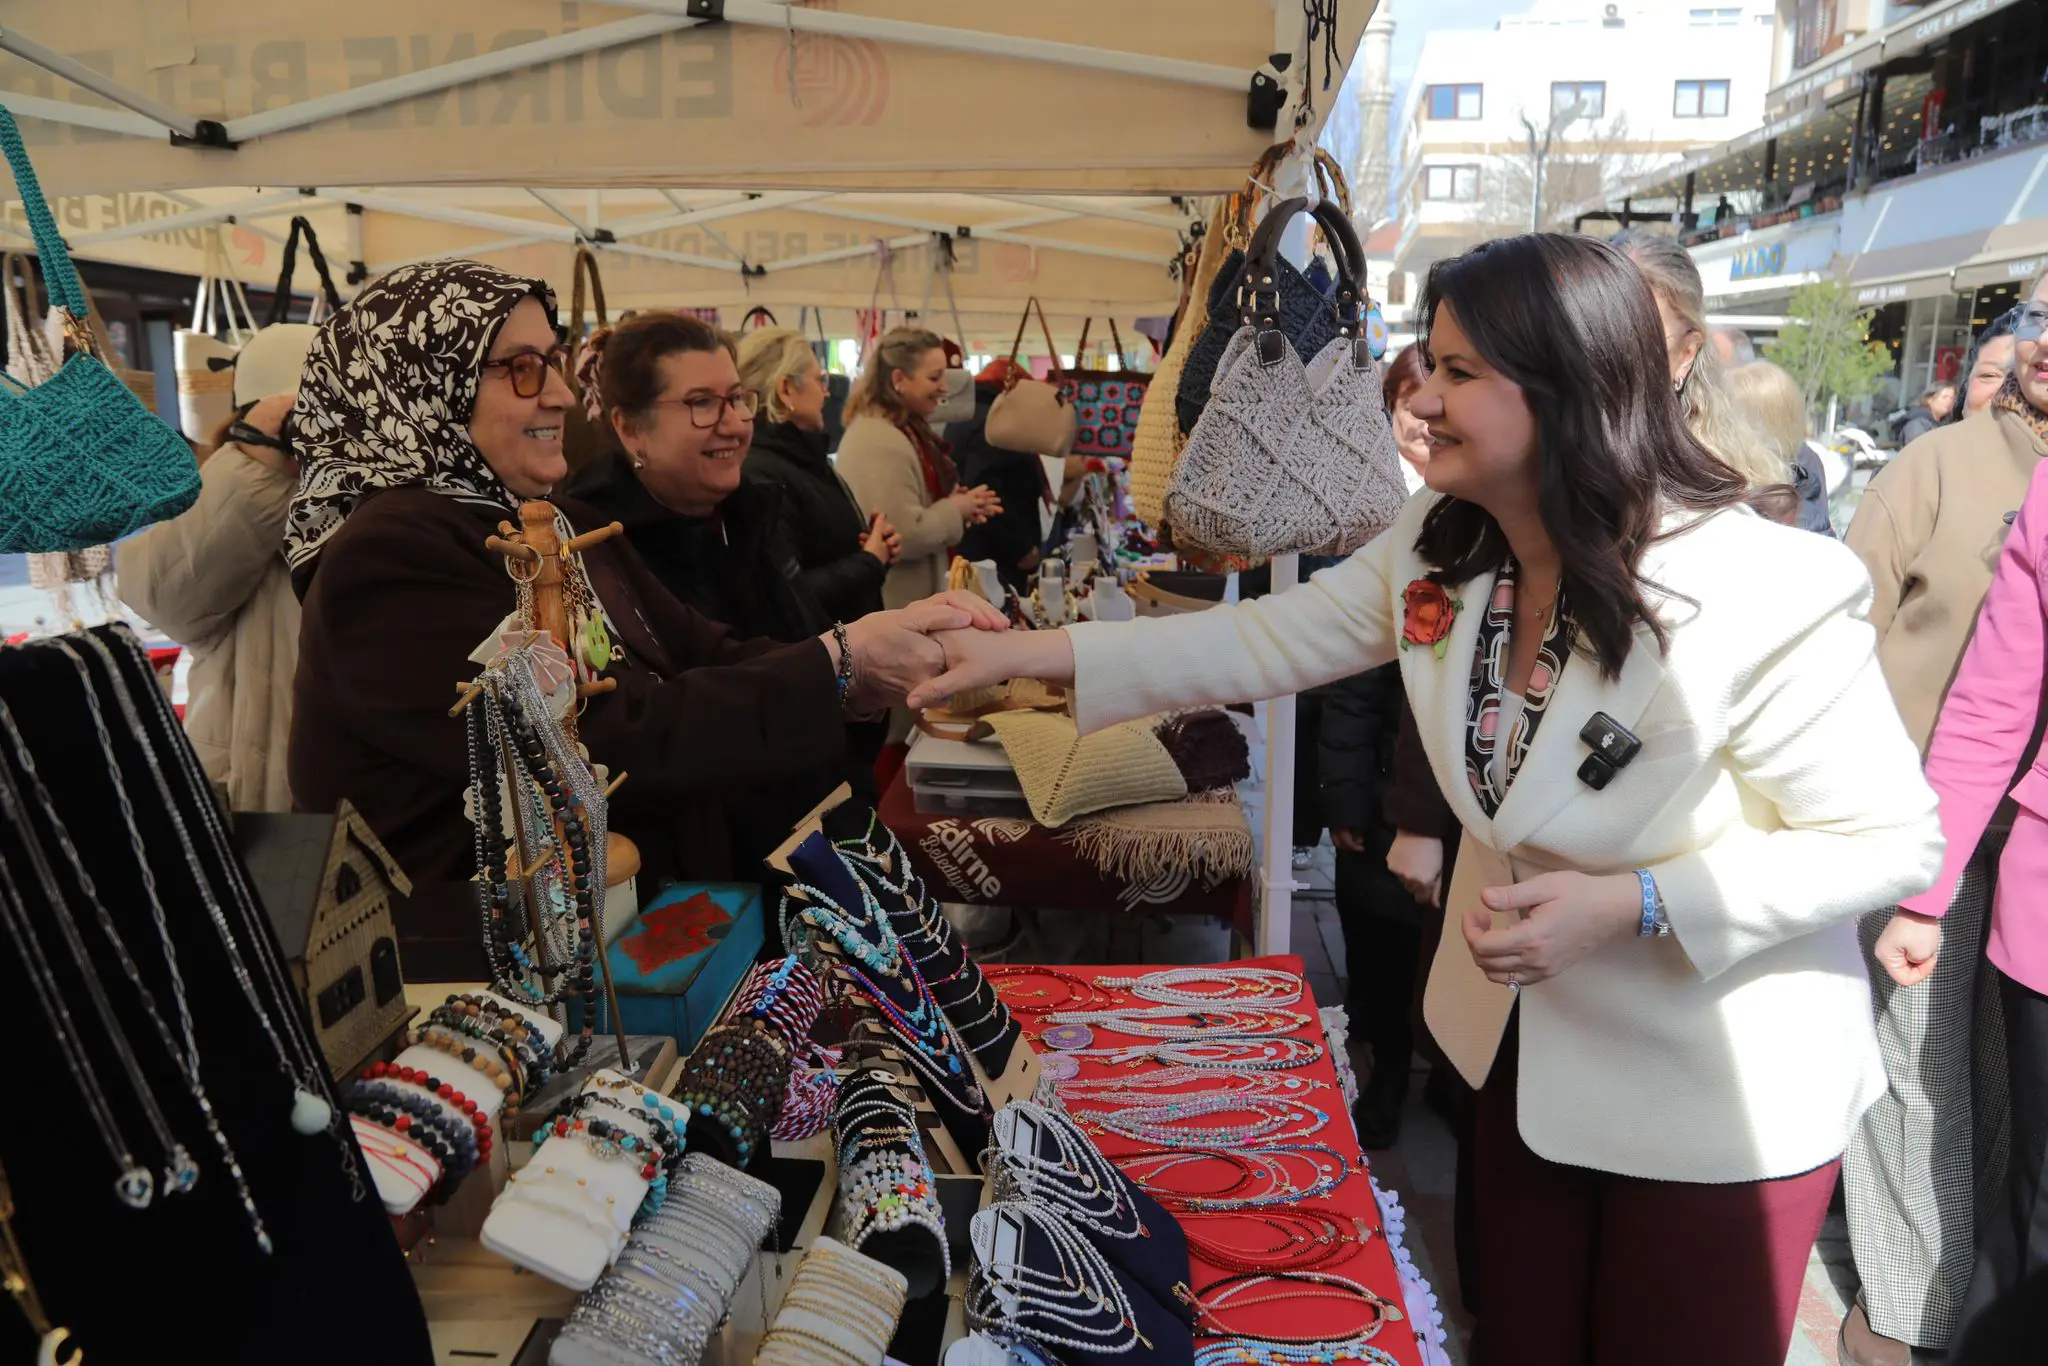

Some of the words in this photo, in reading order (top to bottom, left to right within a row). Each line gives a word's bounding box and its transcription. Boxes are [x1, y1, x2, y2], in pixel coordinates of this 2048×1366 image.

[1730, 242, 1786, 281] MADO
[919, 834, 981, 902] Belediyesi
[926, 818, 1001, 898] Edirne
